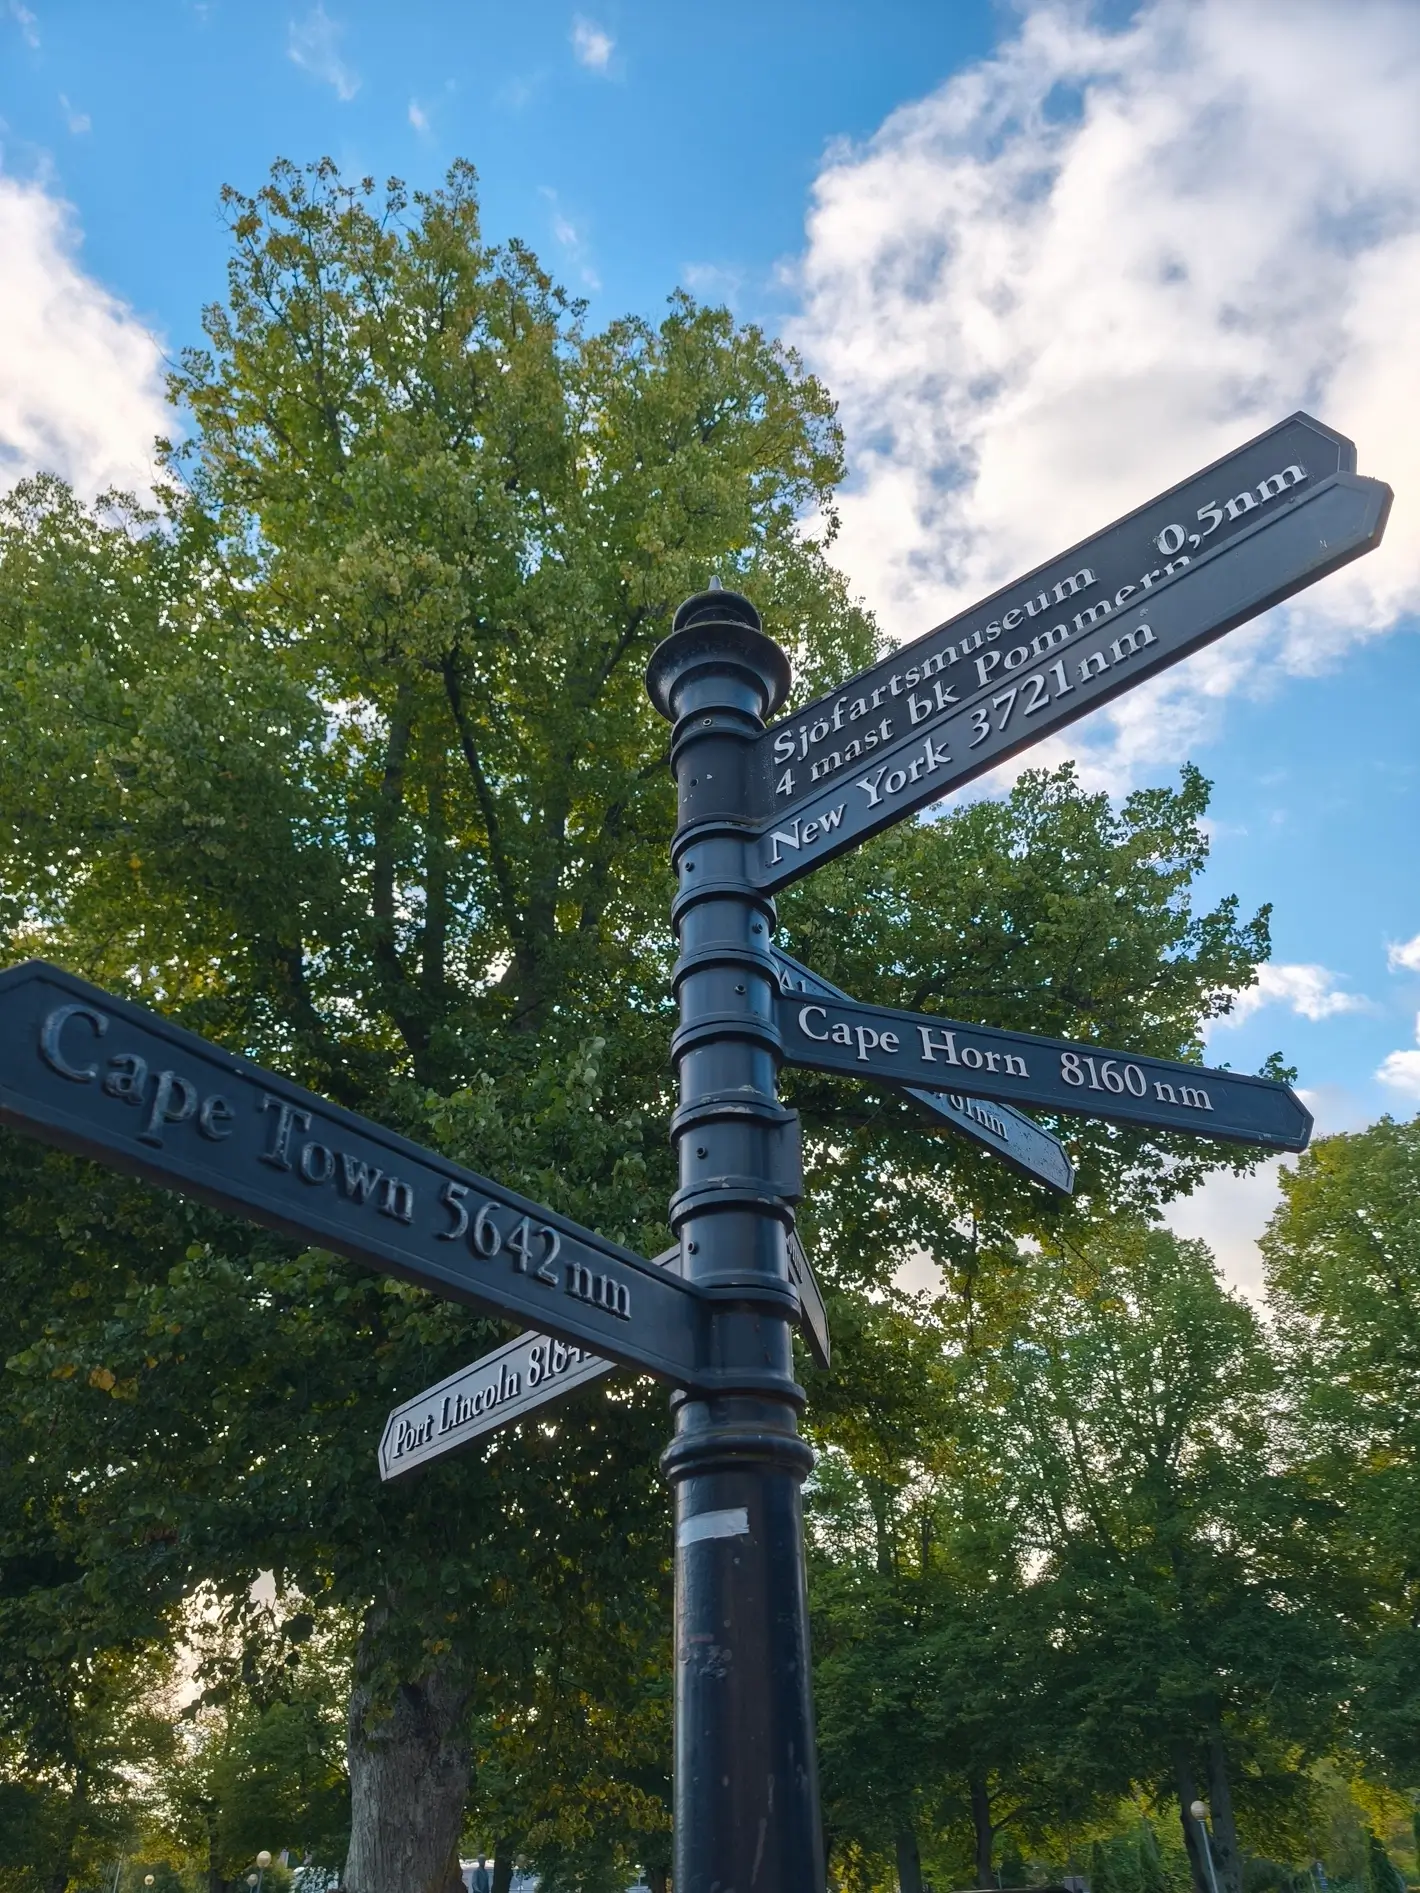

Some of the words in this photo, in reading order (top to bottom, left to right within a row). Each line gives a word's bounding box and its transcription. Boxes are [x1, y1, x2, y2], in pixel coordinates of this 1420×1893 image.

[774, 568, 1099, 765] Sjöfartsmuseum
[776, 769, 796, 796] 4
[811, 718, 895, 782] mast
[907, 681, 960, 725] bk
[770, 803, 847, 864] New
[856, 737, 952, 809] York
[799, 1006, 900, 1060] Cape
[917, 1026, 1029, 1078] Horn
[41, 1004, 236, 1148] Cape
[257, 1096, 415, 1224] Town
[393, 1415, 433, 1459] Port
[438, 1364, 520, 1435] Lincoln
